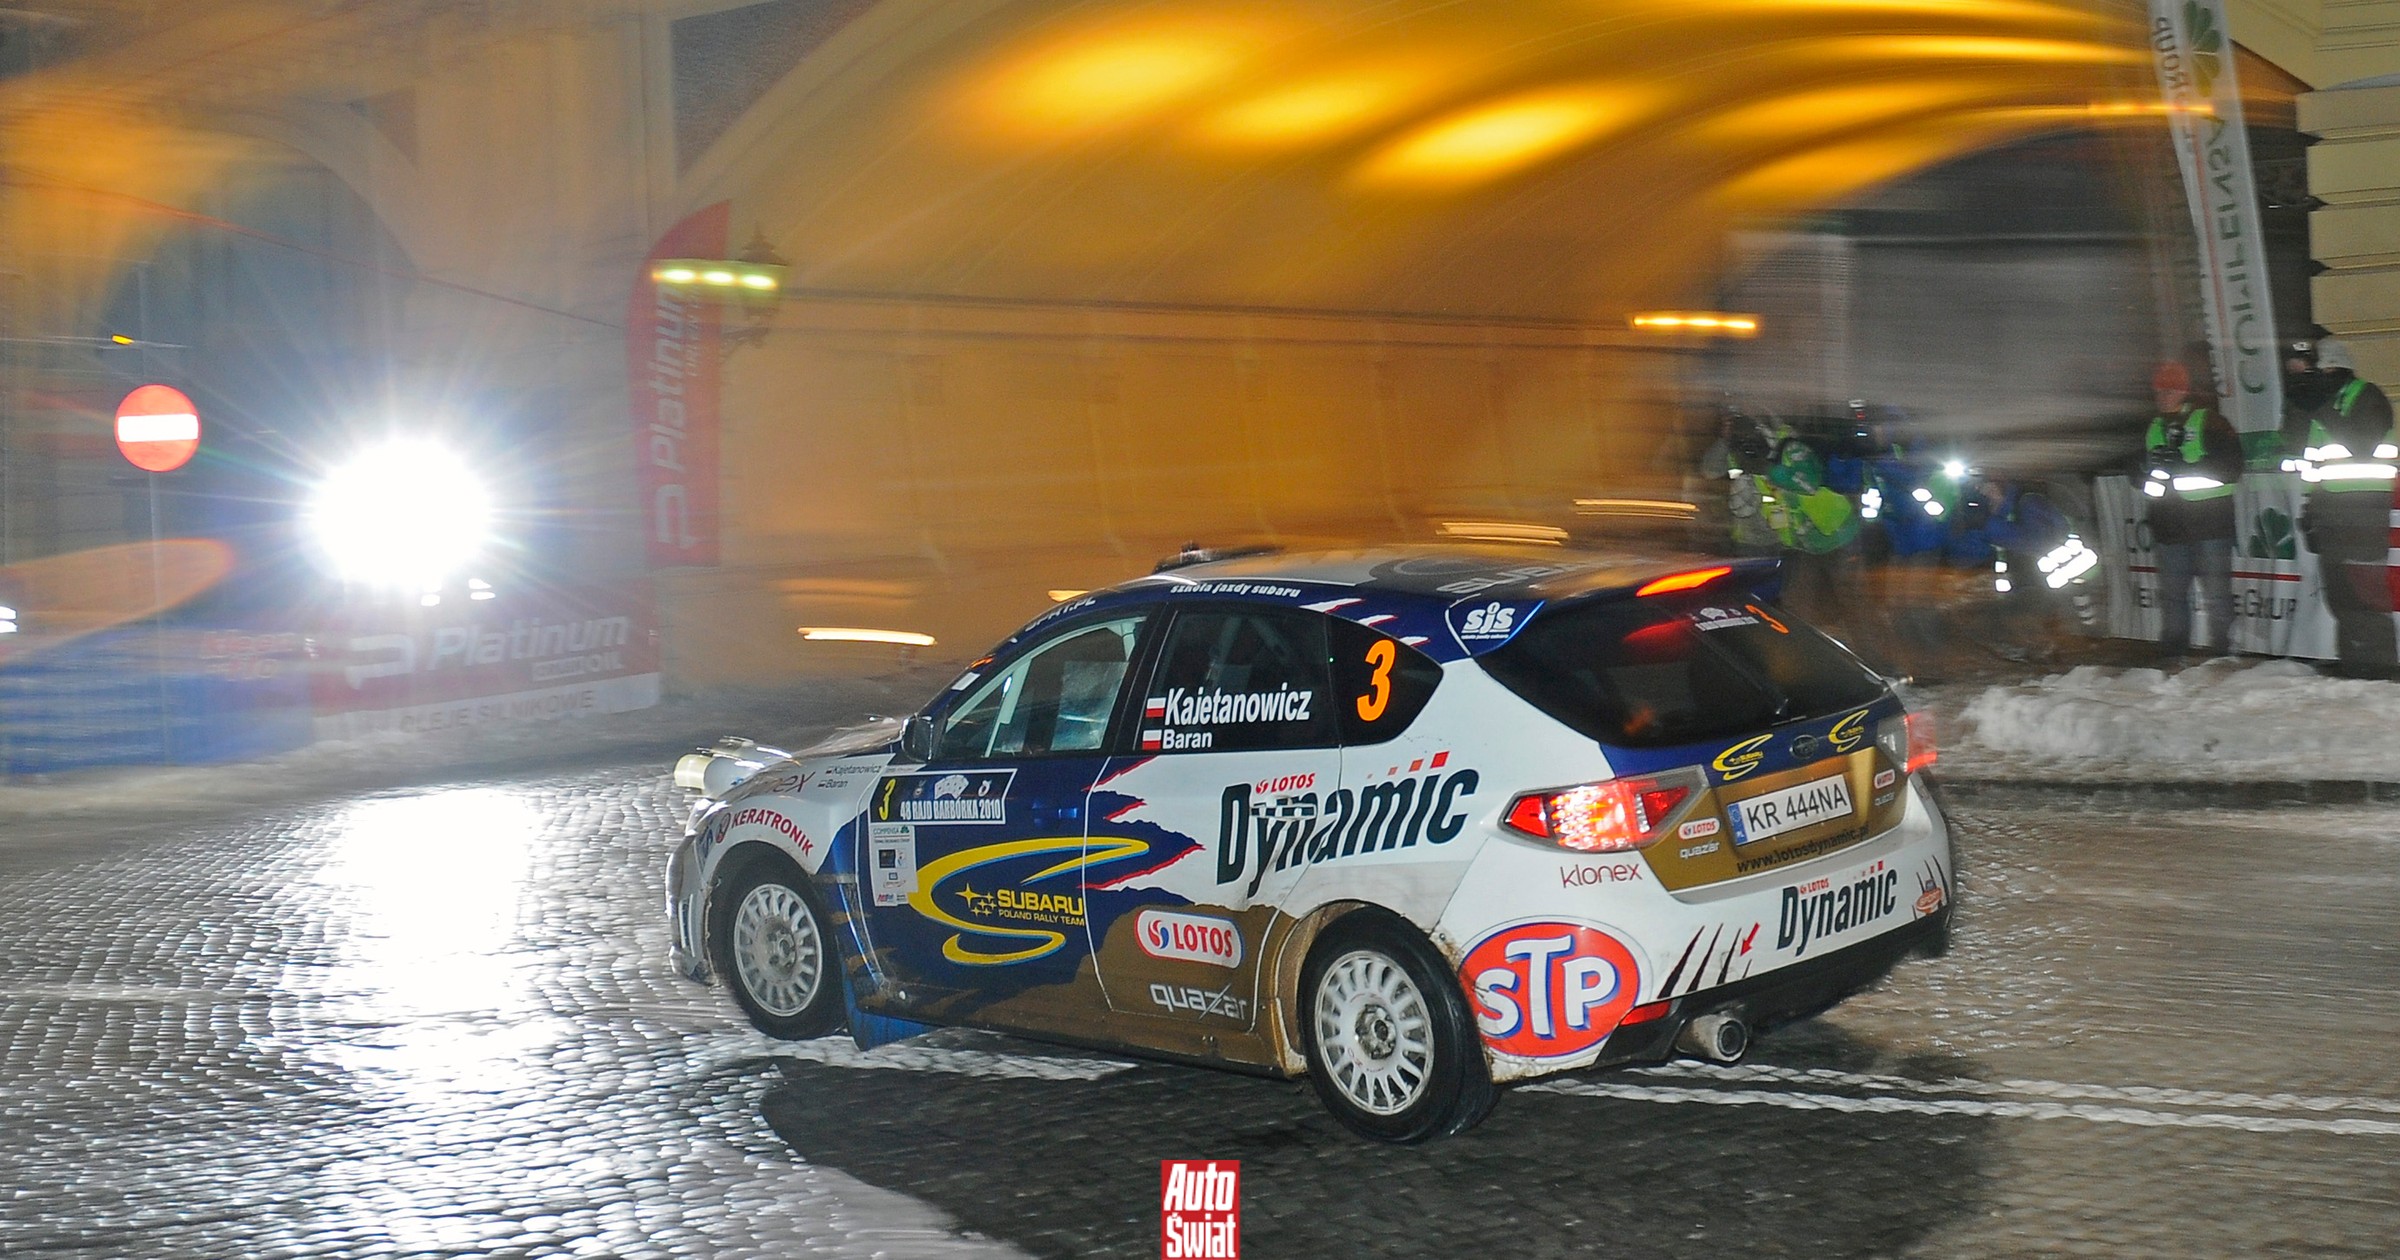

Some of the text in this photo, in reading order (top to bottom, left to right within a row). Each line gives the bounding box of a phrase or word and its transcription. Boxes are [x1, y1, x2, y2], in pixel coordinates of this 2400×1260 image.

[1211, 583, 1251, 596] jazdy
[1251, 585, 1301, 599] subaru
[1462, 602, 1515, 634] sjs
[1744, 604, 1790, 634] 3
[427, 616, 630, 672] Platinum
[1357, 639, 1395, 721] 3
[1164, 682, 1312, 726] Kajetanowicz
[1162, 729, 1212, 749] Baran
[825, 779, 848, 788] Baran
[833, 764, 882, 776] Kajetanowicz
[1271, 773, 1315, 792] LOTOS
[879, 778, 896, 820] 3
[900, 797, 1000, 820] 48 RAJD BARBÓRKA 2010
[1747, 784, 1847, 832] KR 444NA
[731, 808, 813, 857] KERATRONIK
[1216, 752, 1480, 899] Dynamic
[1692, 821, 1716, 834] LOTOS
[1680, 841, 1720, 859] quazar
[1737, 825, 1869, 873] www.lotosdynamic.pl
[1560, 864, 1642, 888] klonex
[1808, 878, 1829, 893] LOTOS
[997, 889, 1083, 916] SUBARU
[999, 909, 1085, 927] POLAND RALLY TEAM
[1777, 863, 1897, 957] Dynamic
[1173, 923, 1232, 957] LOTOS
[1150, 983, 1247, 1020] quazar
[1475, 934, 1621, 1040] STP
